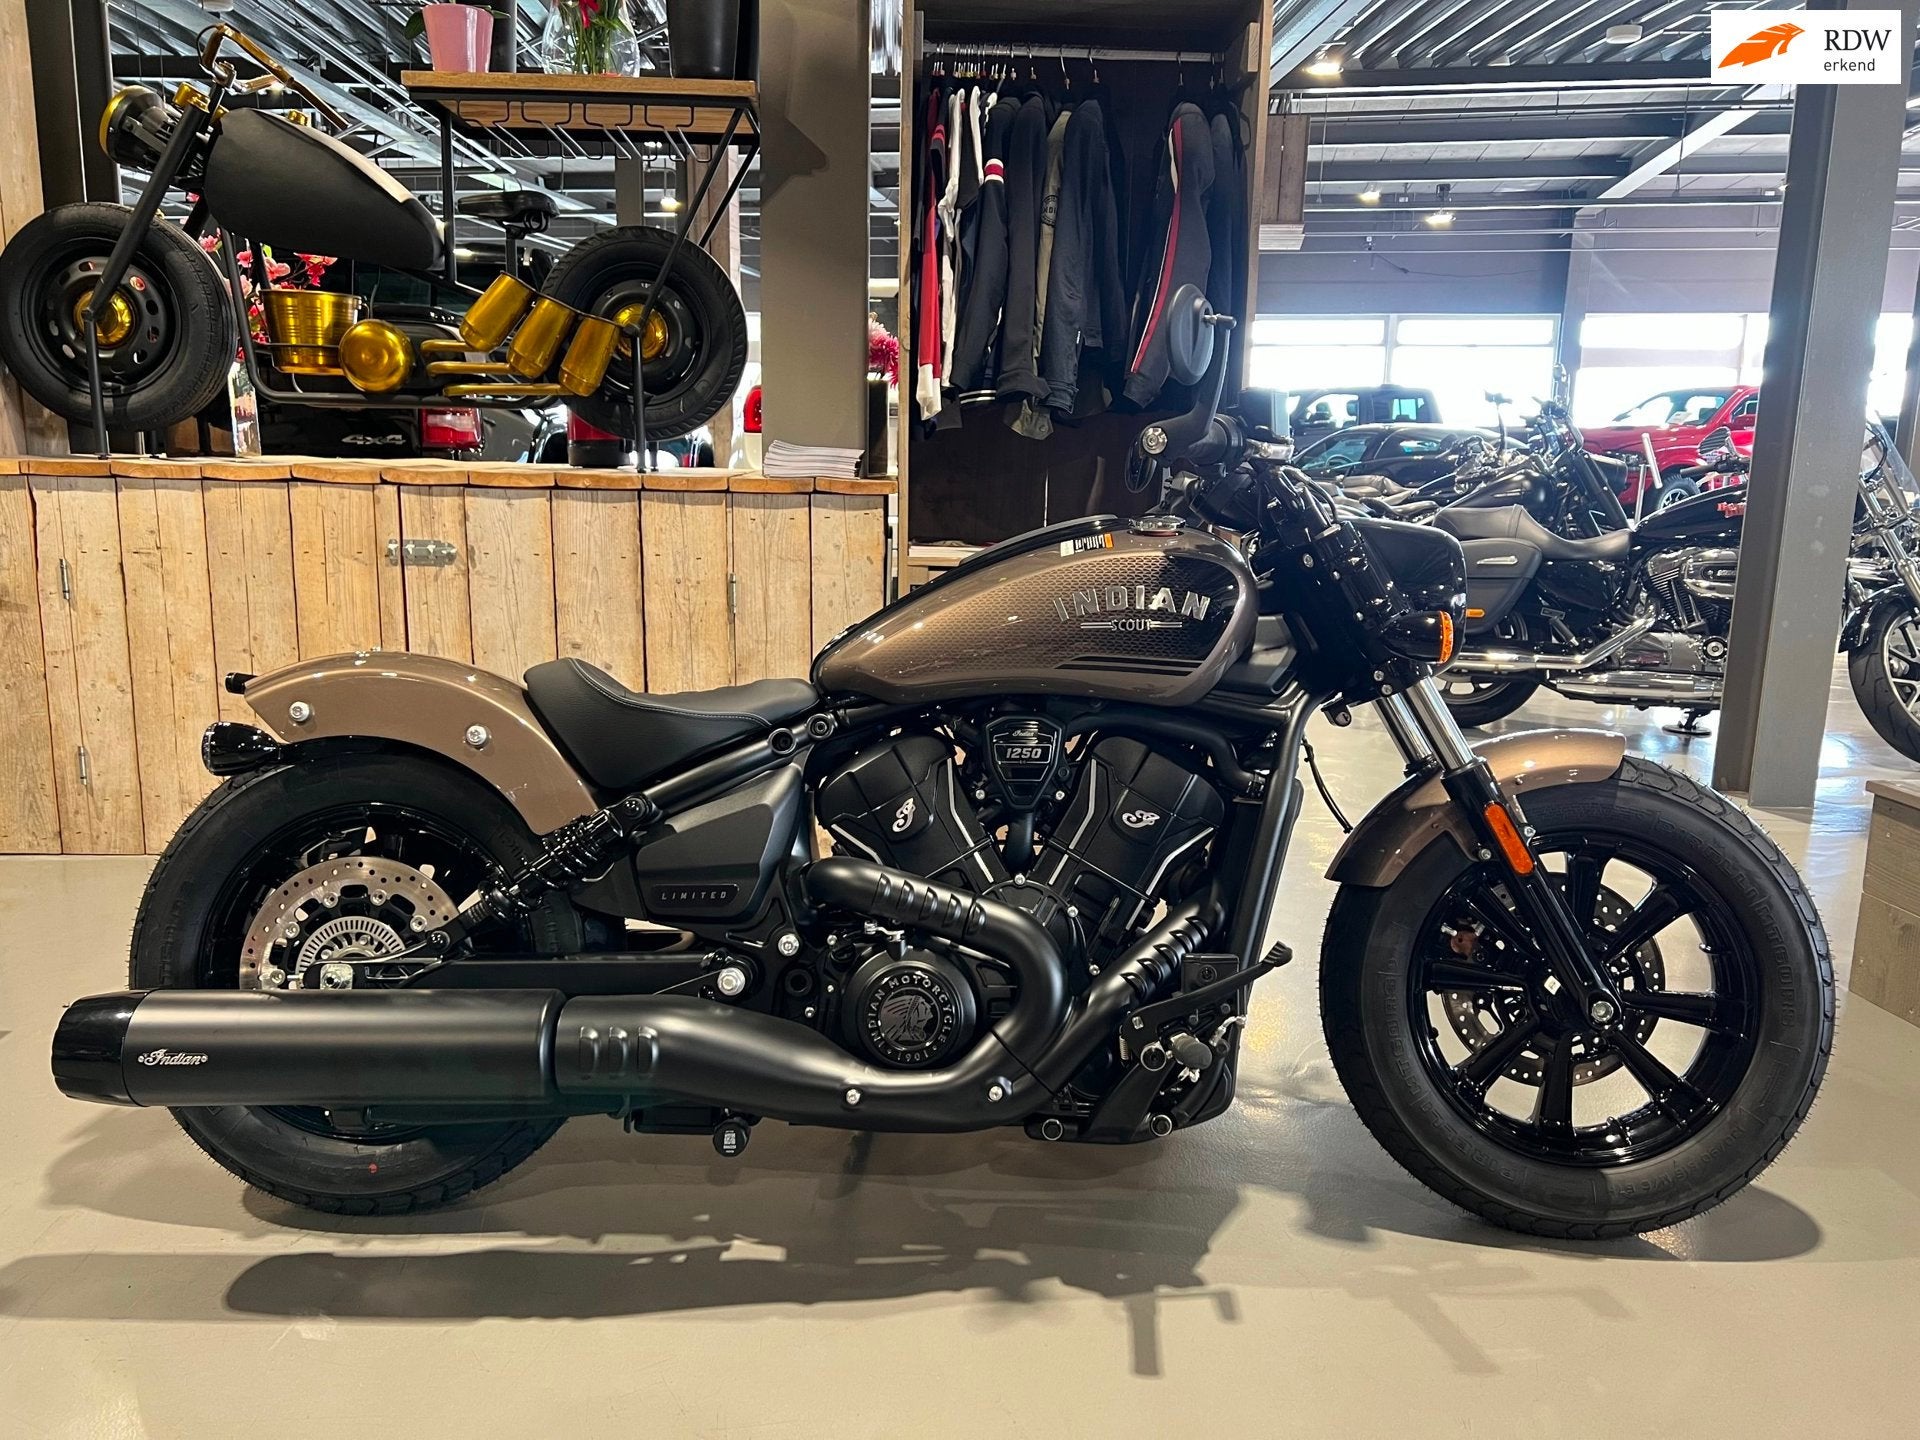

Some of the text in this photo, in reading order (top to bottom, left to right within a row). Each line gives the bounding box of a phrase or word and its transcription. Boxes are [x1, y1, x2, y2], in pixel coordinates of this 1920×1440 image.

[341, 434, 406, 445] 4x4
[1053, 585, 1211, 622] INDIAN
[1111, 618, 1152, 631] SCOUT
[1006, 747, 1042, 759] 1250
[661, 891, 727, 900] LIMITED
[868, 989, 886, 1048] INDIAN
[889, 975, 953, 1043] MOTORCYCLE
[143, 1048, 201, 1066] Indian
